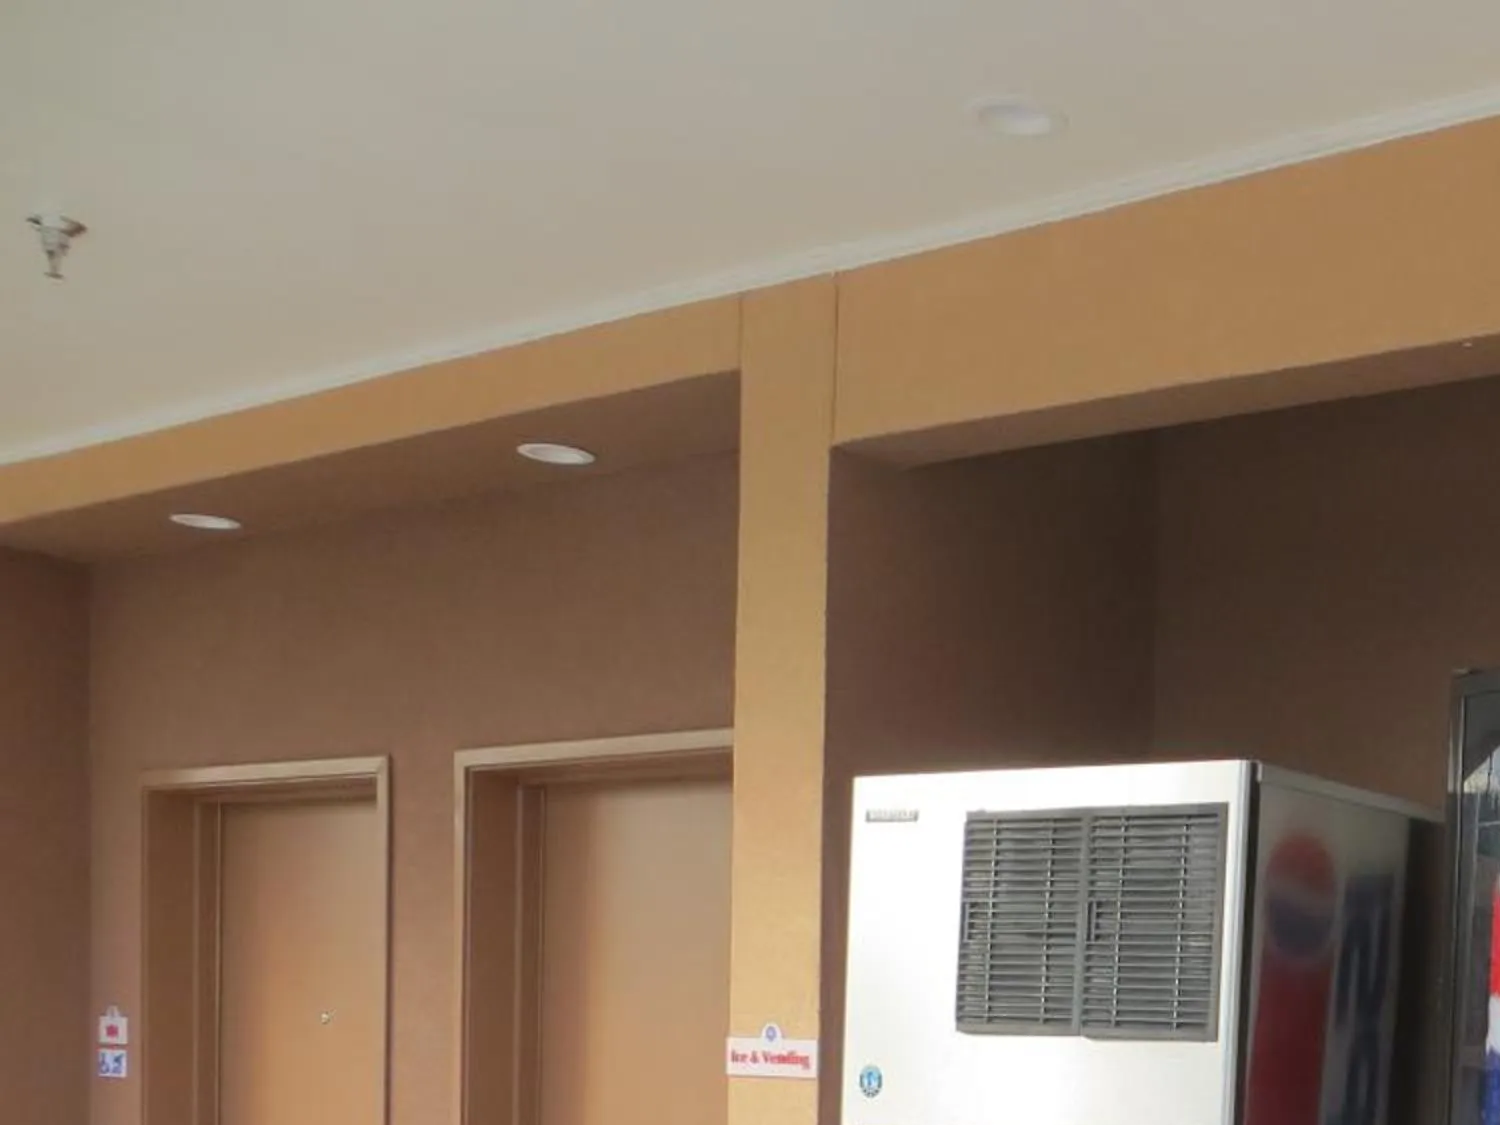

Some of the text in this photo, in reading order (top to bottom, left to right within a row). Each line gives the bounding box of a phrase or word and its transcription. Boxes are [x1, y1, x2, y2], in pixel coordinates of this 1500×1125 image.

[731, 1051, 811, 1069] Ice & Vending
